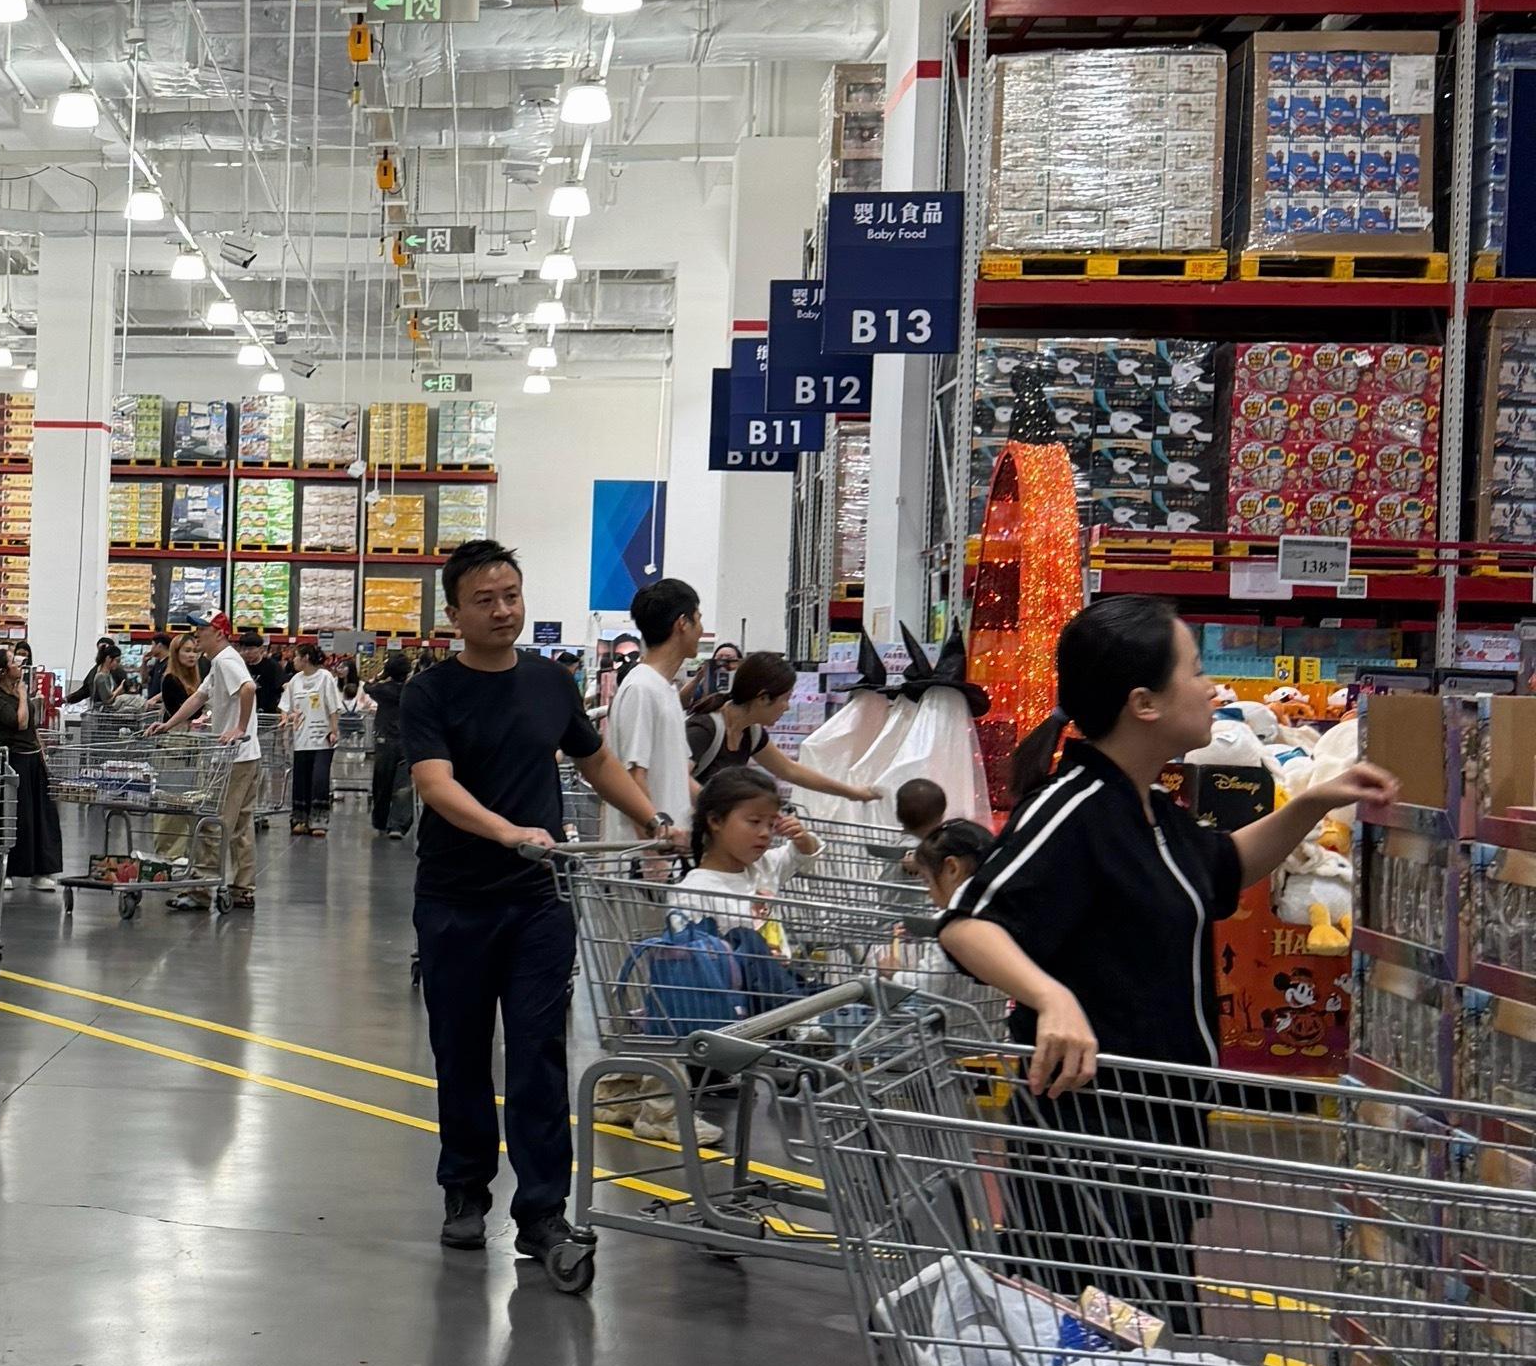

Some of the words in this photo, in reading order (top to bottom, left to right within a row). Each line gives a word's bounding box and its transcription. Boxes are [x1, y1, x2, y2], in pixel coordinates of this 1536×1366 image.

[853, 201, 943, 225] 婴儿食品
[866, 228, 896, 242] Baby
[898, 228, 927, 239] Food
[796, 309, 821, 321] Baby
[851, 308, 932, 344] B13
[794, 375, 861, 405] B12
[748, 420, 801, 446] B11
[1301, 559, 1328, 574] 138
[1211, 773, 1262, 795] Disney
